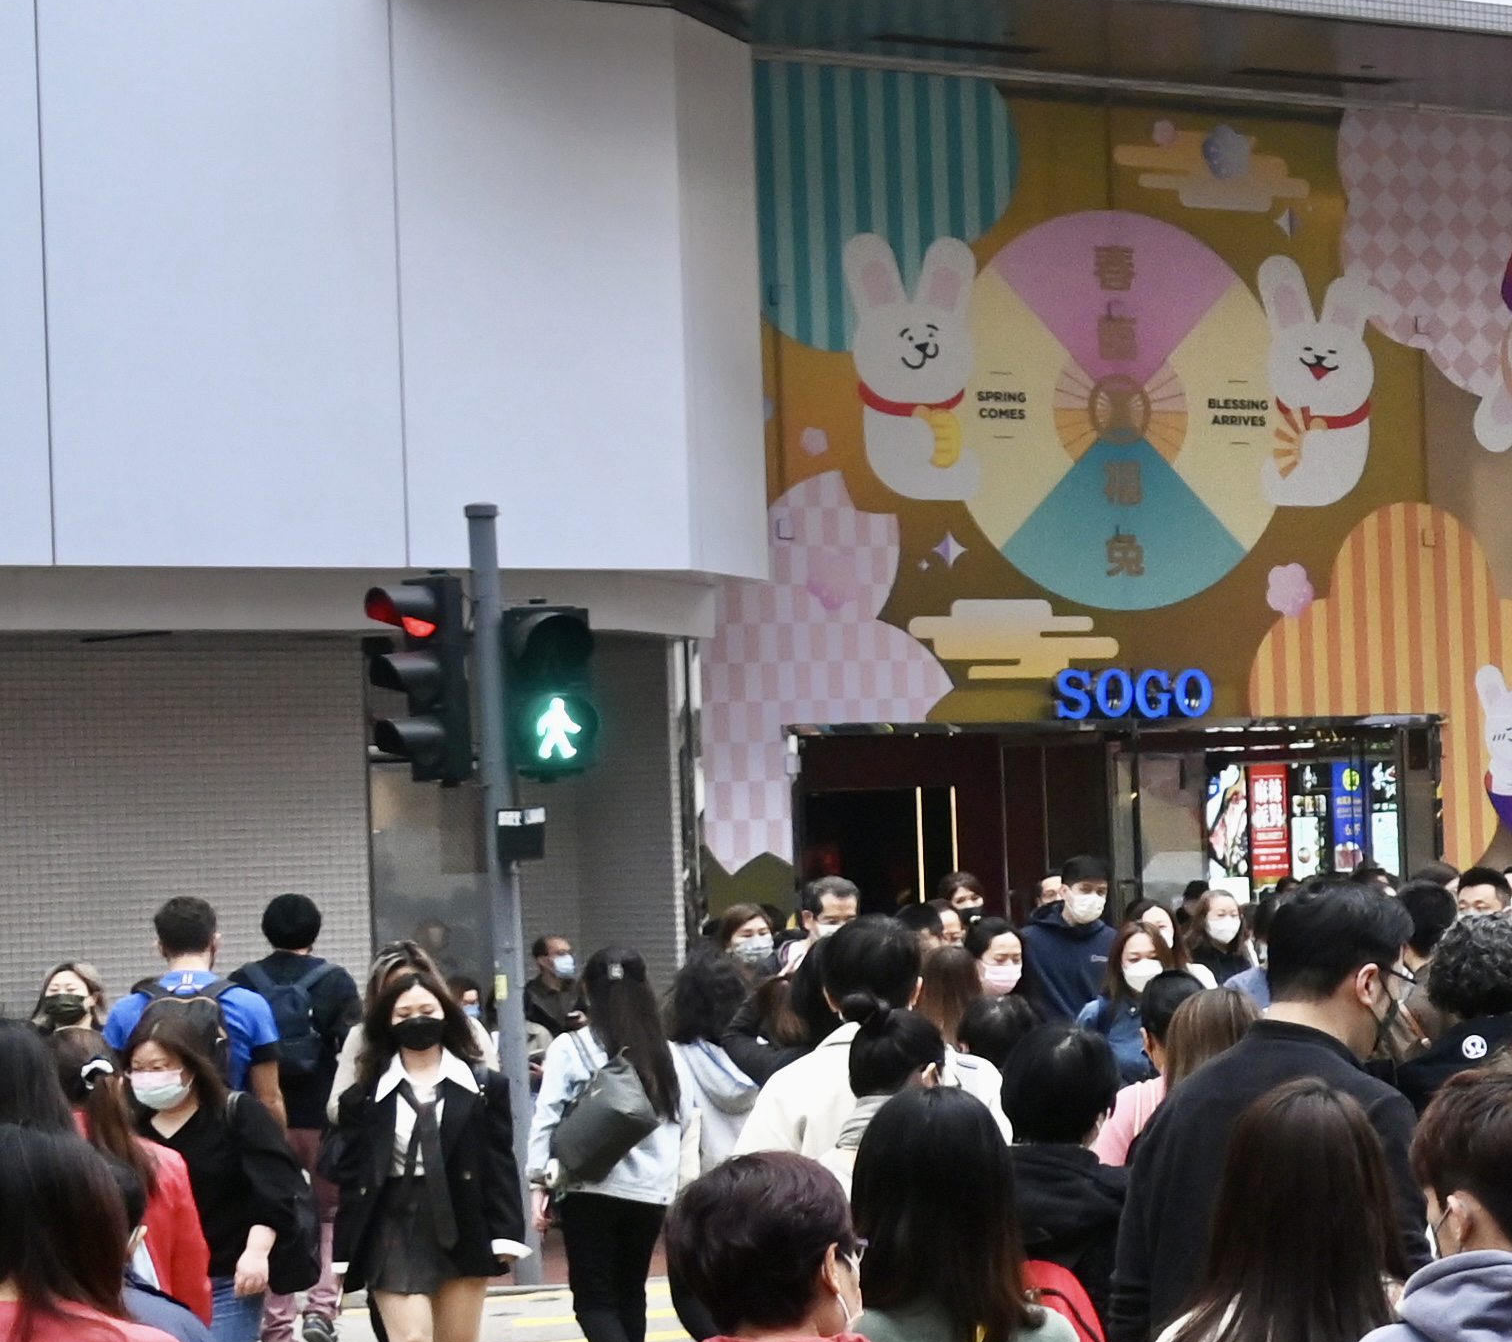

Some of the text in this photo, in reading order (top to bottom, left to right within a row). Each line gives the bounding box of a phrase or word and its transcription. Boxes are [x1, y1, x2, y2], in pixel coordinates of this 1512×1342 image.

[977, 390, 1027, 404] SPRING
[1207, 397, 1269, 411] BLESSING
[978, 407, 1026, 421] COMES
[1211, 415, 1266, 427] ARRIVES
[1054, 667, 1214, 721] SOGO
